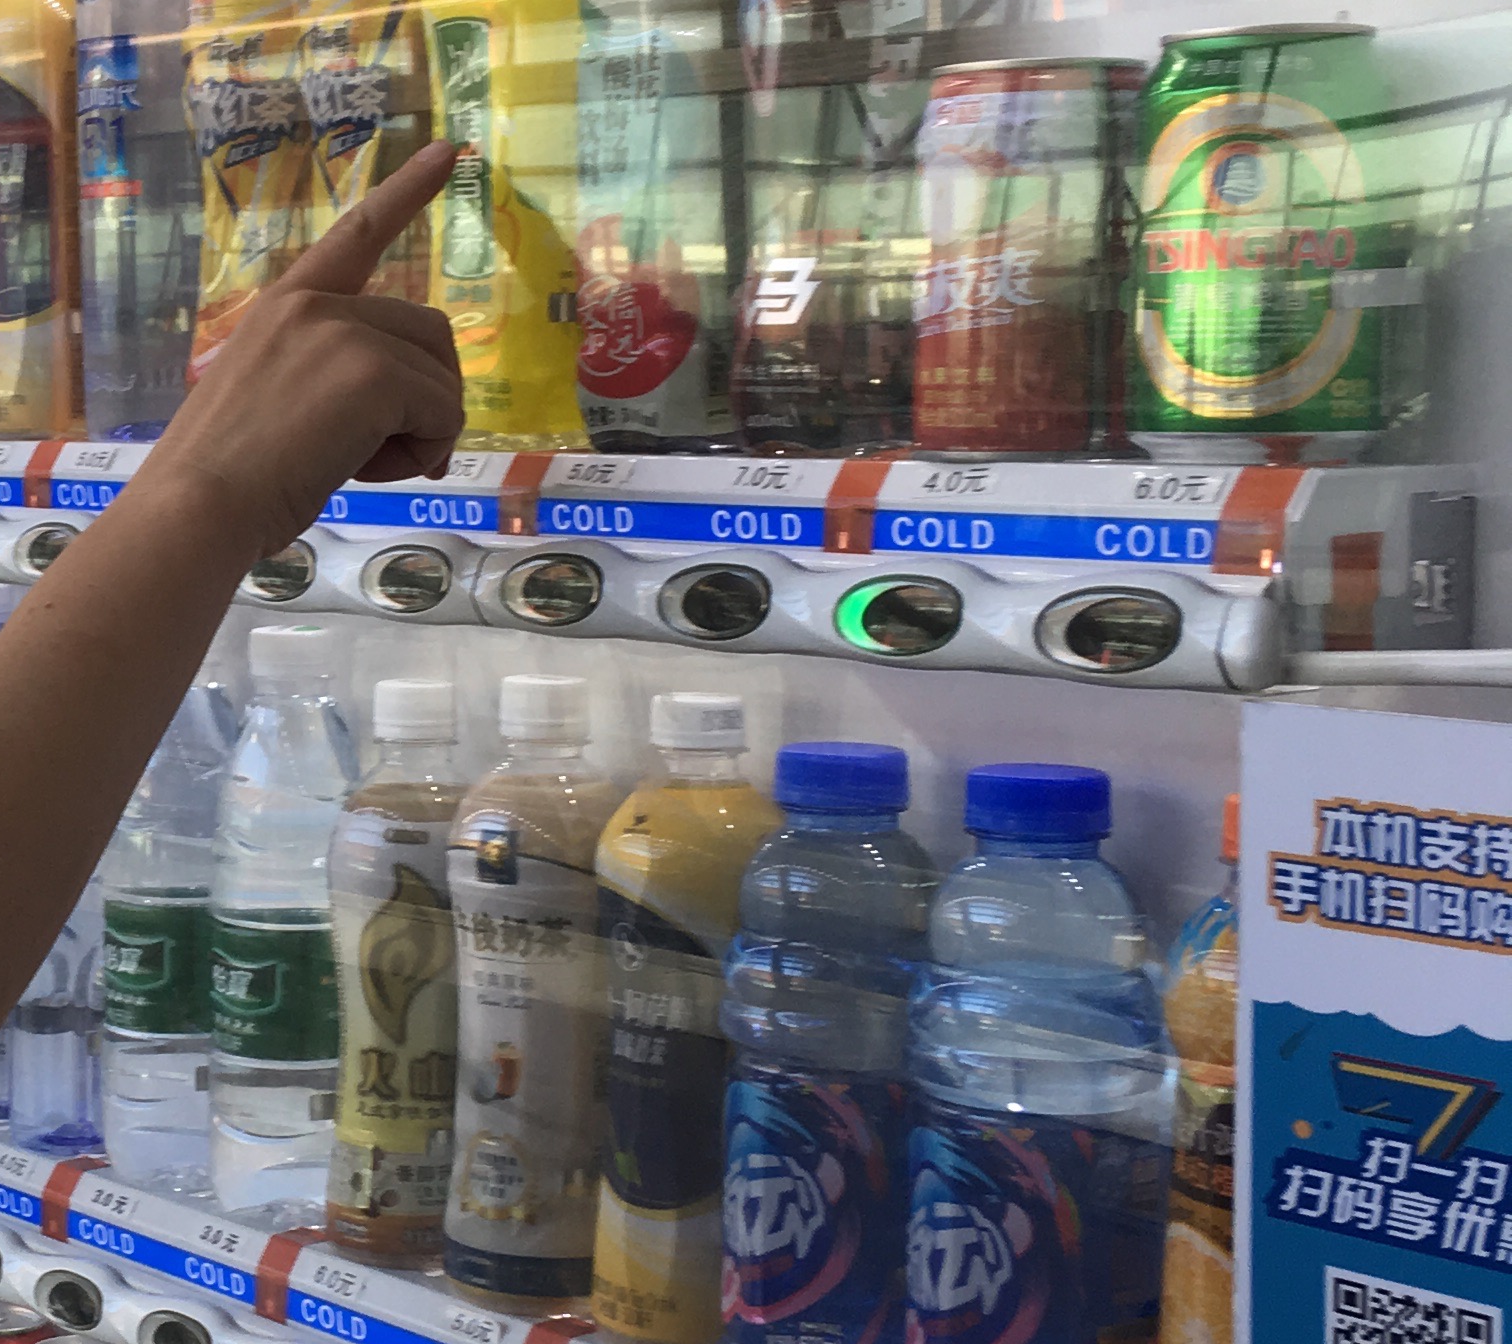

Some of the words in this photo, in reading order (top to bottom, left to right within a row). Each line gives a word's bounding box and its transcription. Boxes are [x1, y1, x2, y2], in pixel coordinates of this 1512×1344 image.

[1141, 226, 1357, 274] TSINGTAO
[734, 465, 788, 491] 7.0元
[923, 467, 991, 494] 4.0元
[1136, 472, 1213, 503] 6.0元
[57, 484, 114, 507] COLD
[409, 498, 484, 526] COLD
[551, 503, 635, 533] COLD
[711, 511, 803, 542] COLD
[891, 516, 995, 550] COLD
[1095, 523, 1213, 560] COLD
[1360, 1137, 1510, 1205] 扫一扫
[78, 1218, 135, 1255] COLD
[185, 1256, 246, 1296] COLD
[300, 1298, 367, 1341] COLD
